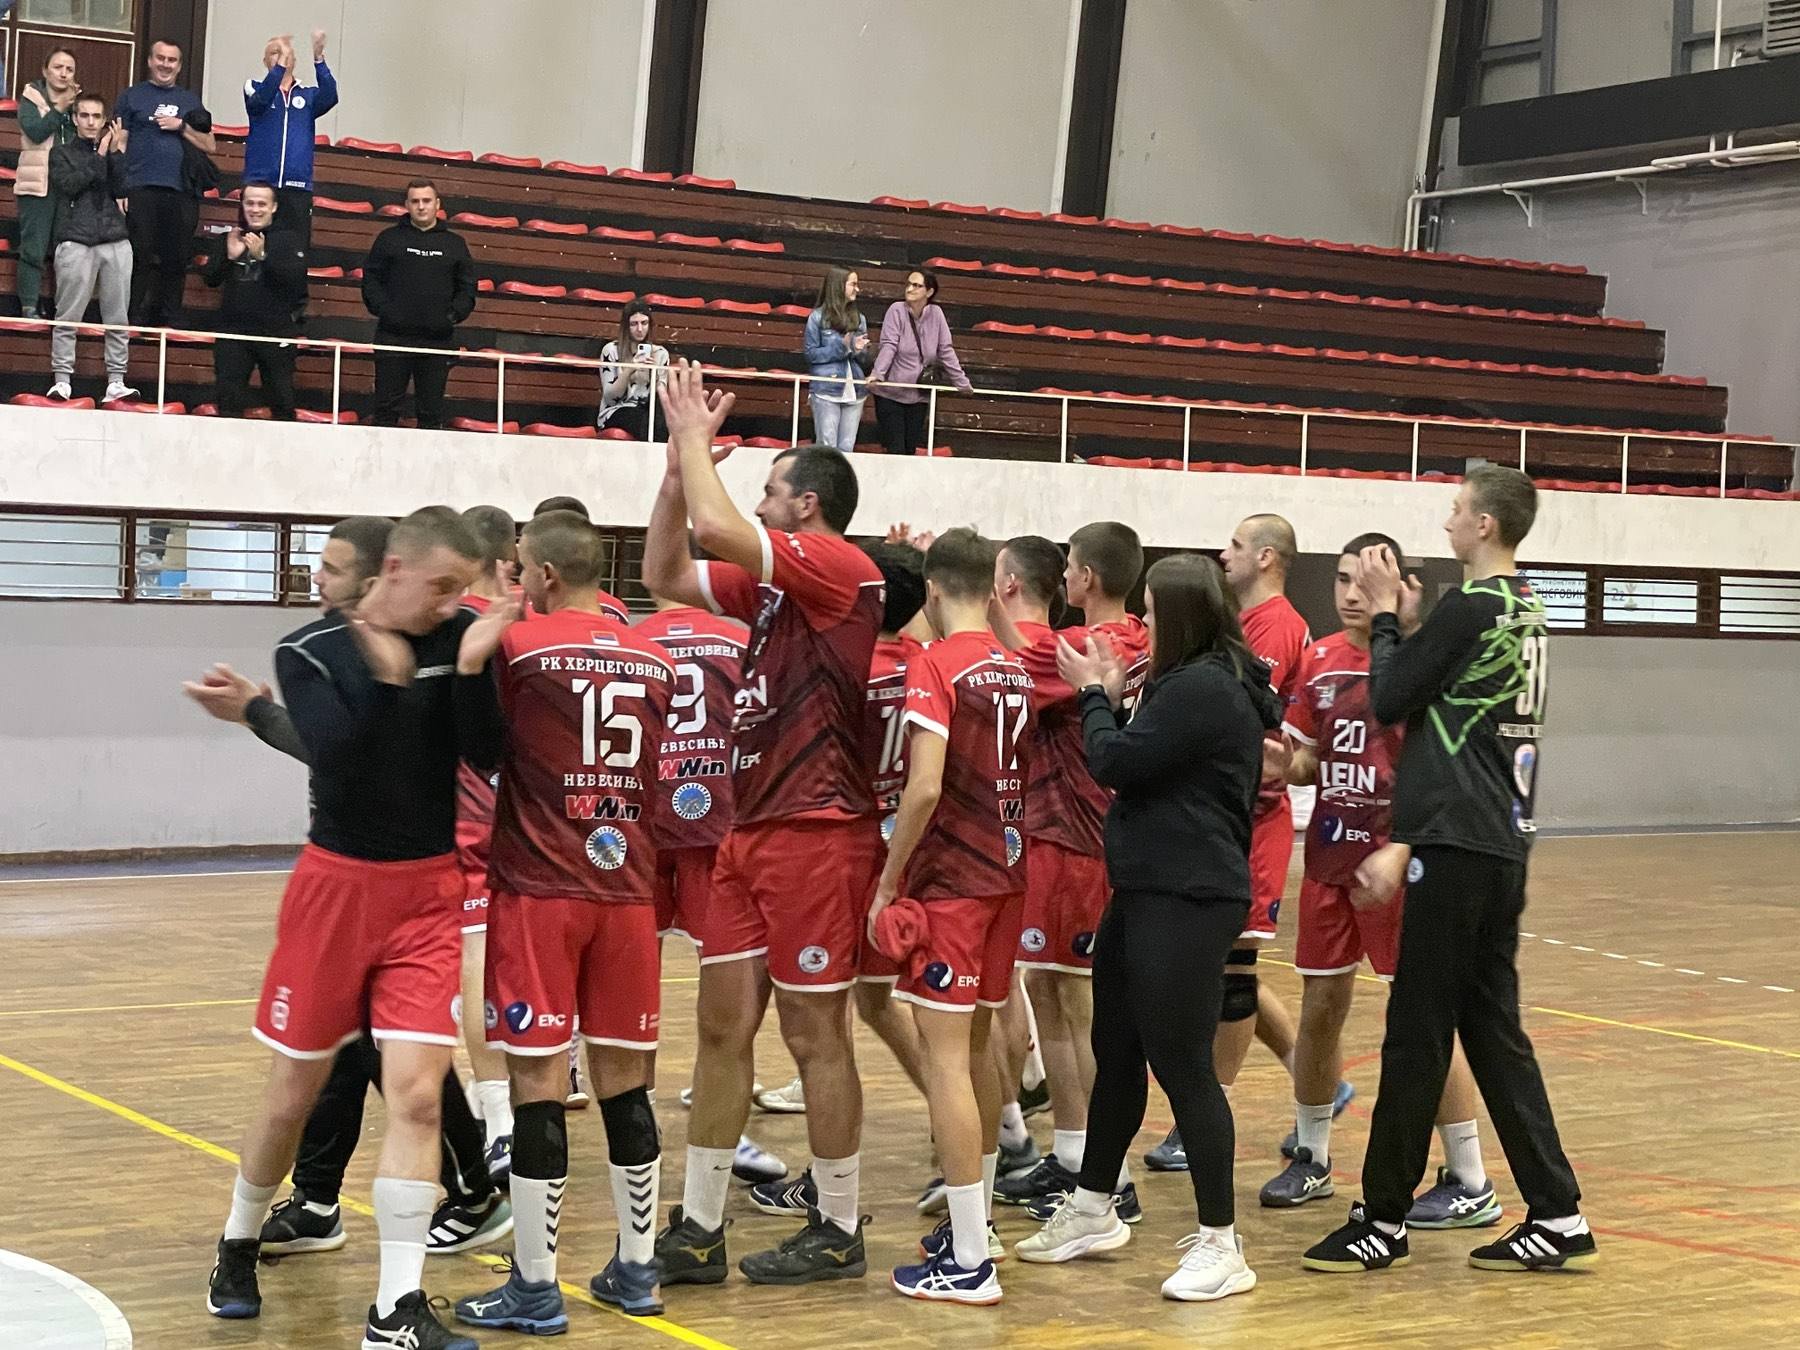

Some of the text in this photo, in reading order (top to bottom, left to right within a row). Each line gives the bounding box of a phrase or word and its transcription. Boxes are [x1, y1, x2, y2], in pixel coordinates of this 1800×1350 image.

[666, 645, 739, 659] ЦЕГОВИНА
[540, 656, 668, 682] РК ХЕРЦЕГОВИНА
[571, 678, 647, 769] 15
[992, 691, 1029, 771] 17
[1333, 719, 1366, 754] 20
[660, 738, 727, 754] ЕВЕСИЊЕ
[658, 755, 727, 780] WWin
[565, 794, 643, 822] WWin
